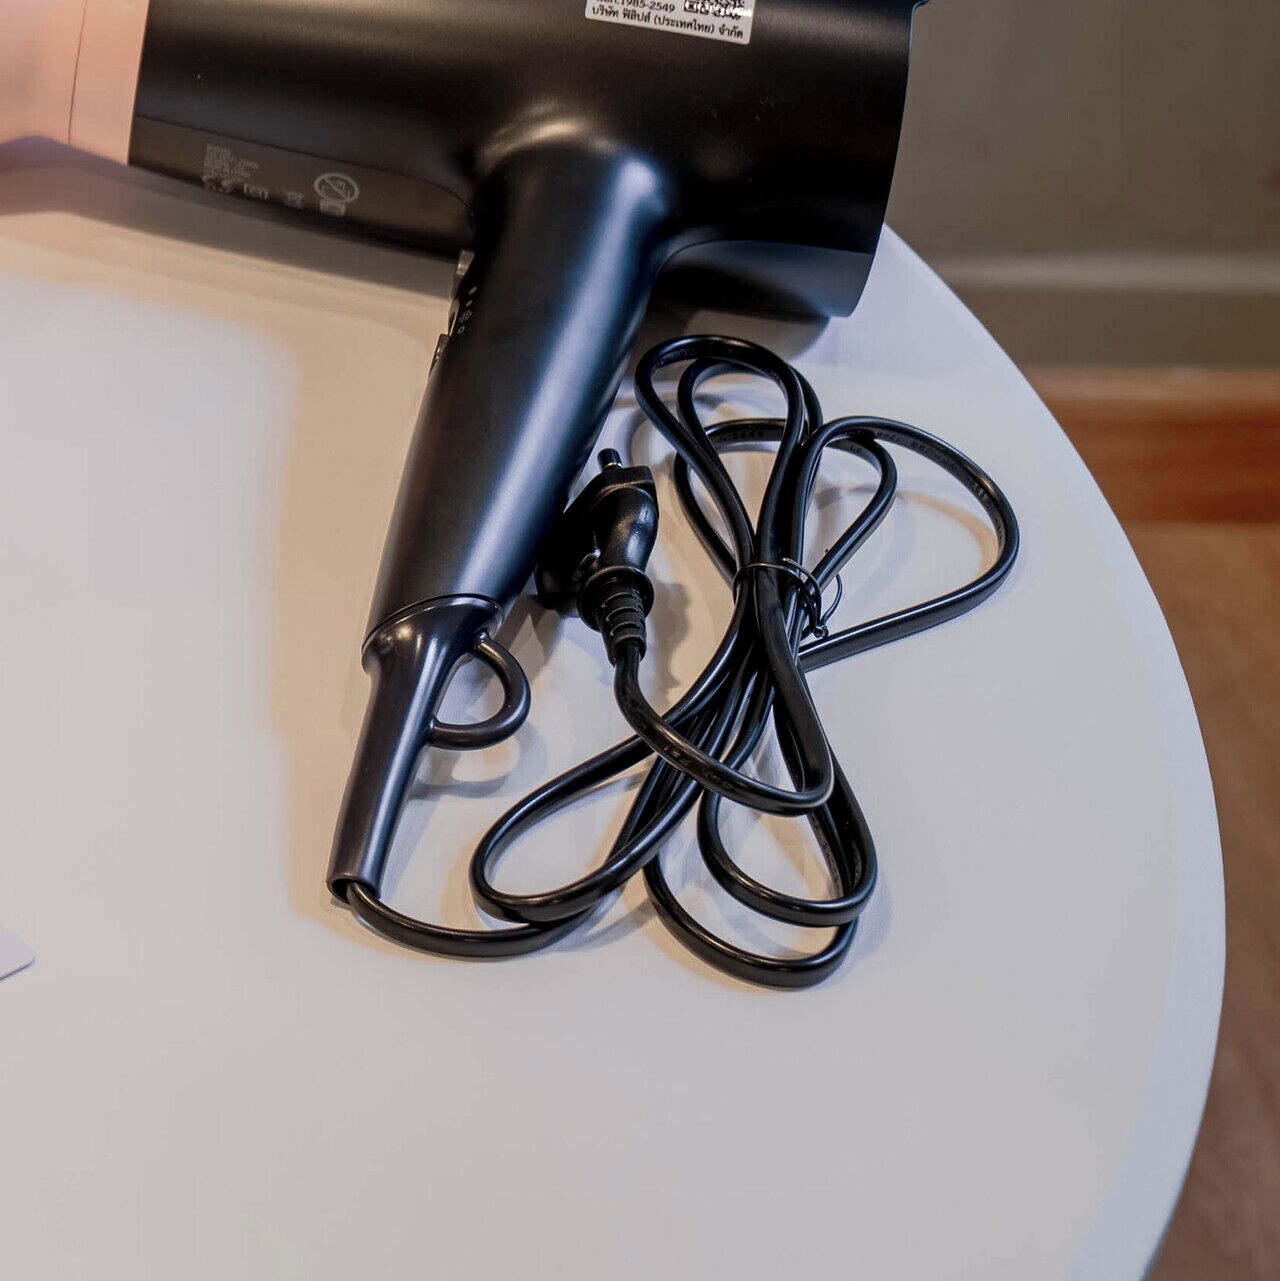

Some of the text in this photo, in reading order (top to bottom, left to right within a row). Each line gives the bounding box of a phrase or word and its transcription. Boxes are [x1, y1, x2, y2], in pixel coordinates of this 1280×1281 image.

[592, 4, 618, 18] บริษัท
[654, 14, 715, 34] (ประเทศไทย)
[718, 23, 743, 39] จำกัด
